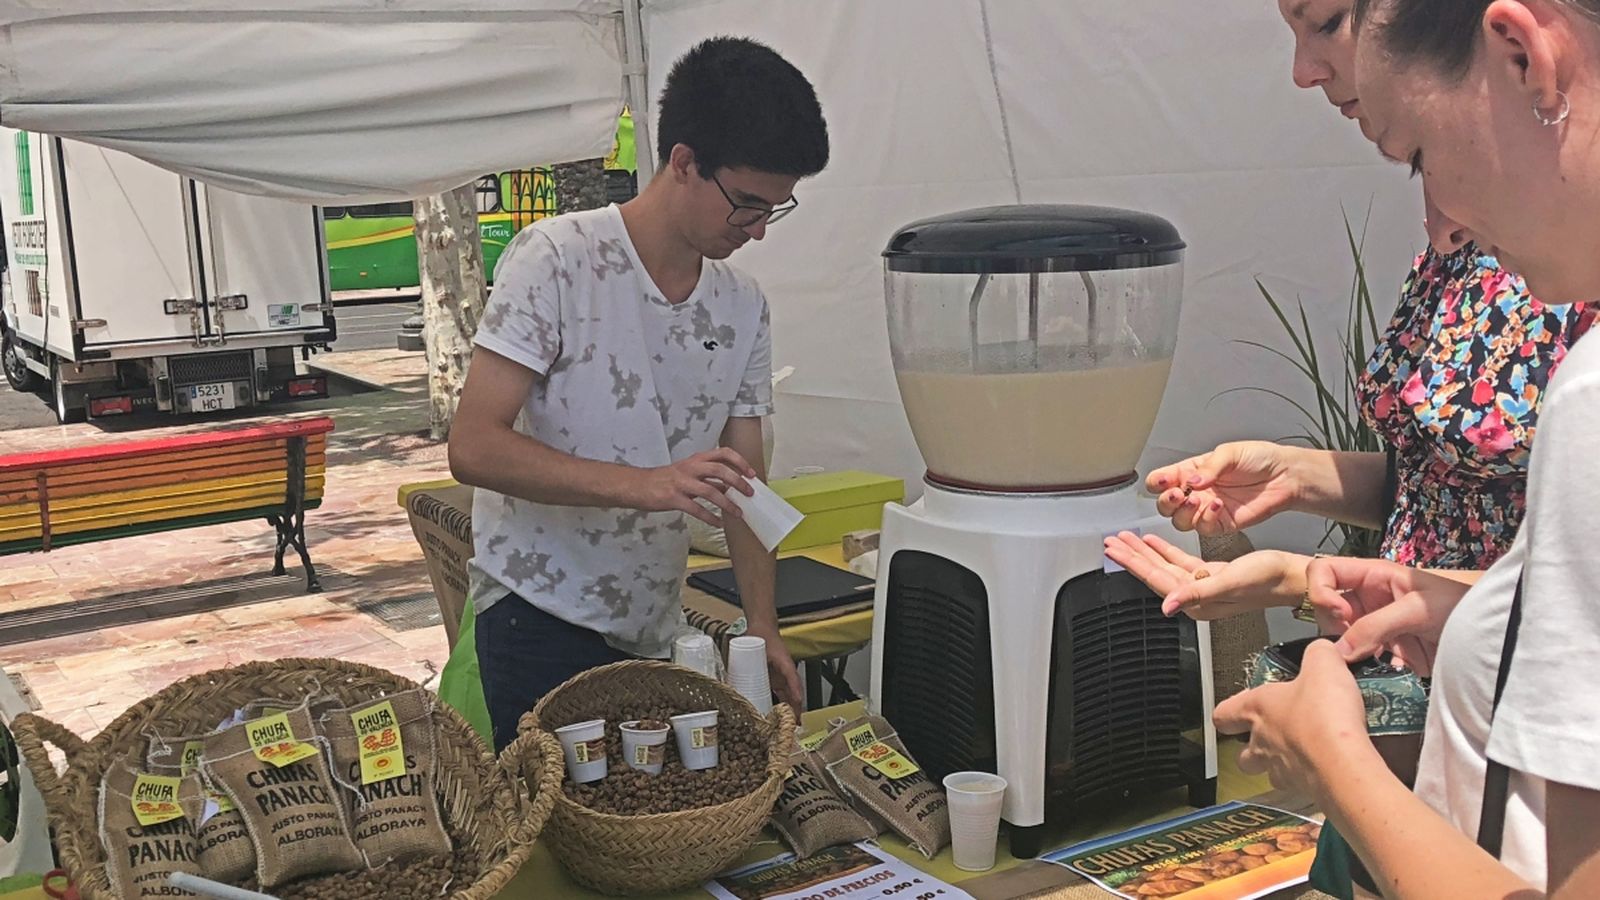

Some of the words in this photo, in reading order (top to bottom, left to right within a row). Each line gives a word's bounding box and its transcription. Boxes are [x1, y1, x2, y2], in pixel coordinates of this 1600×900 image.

[197, 384, 225, 398] 5231
[202, 397, 224, 410] HCT
[357, 708, 392, 730] CHUFA
[252, 721, 288, 742] CHUFA
[849, 729, 875, 748] CHUFA
[246, 763, 320, 789] CHUFAS
[137, 782, 174, 798] CHUFA
[385, 804, 427, 816] PANACH
[271, 814, 305, 834] JUSTO
[1073, 839, 1177, 875] CHUFAS
[1166, 809, 1275, 848] PANACH
[127, 839, 197, 868] PANAC
[749, 867, 791, 884] CHUFAS
[789, 853, 836, 872] PANACH
[823, 887, 845, 898] DE
[841, 870, 896, 893] PRECIOS
